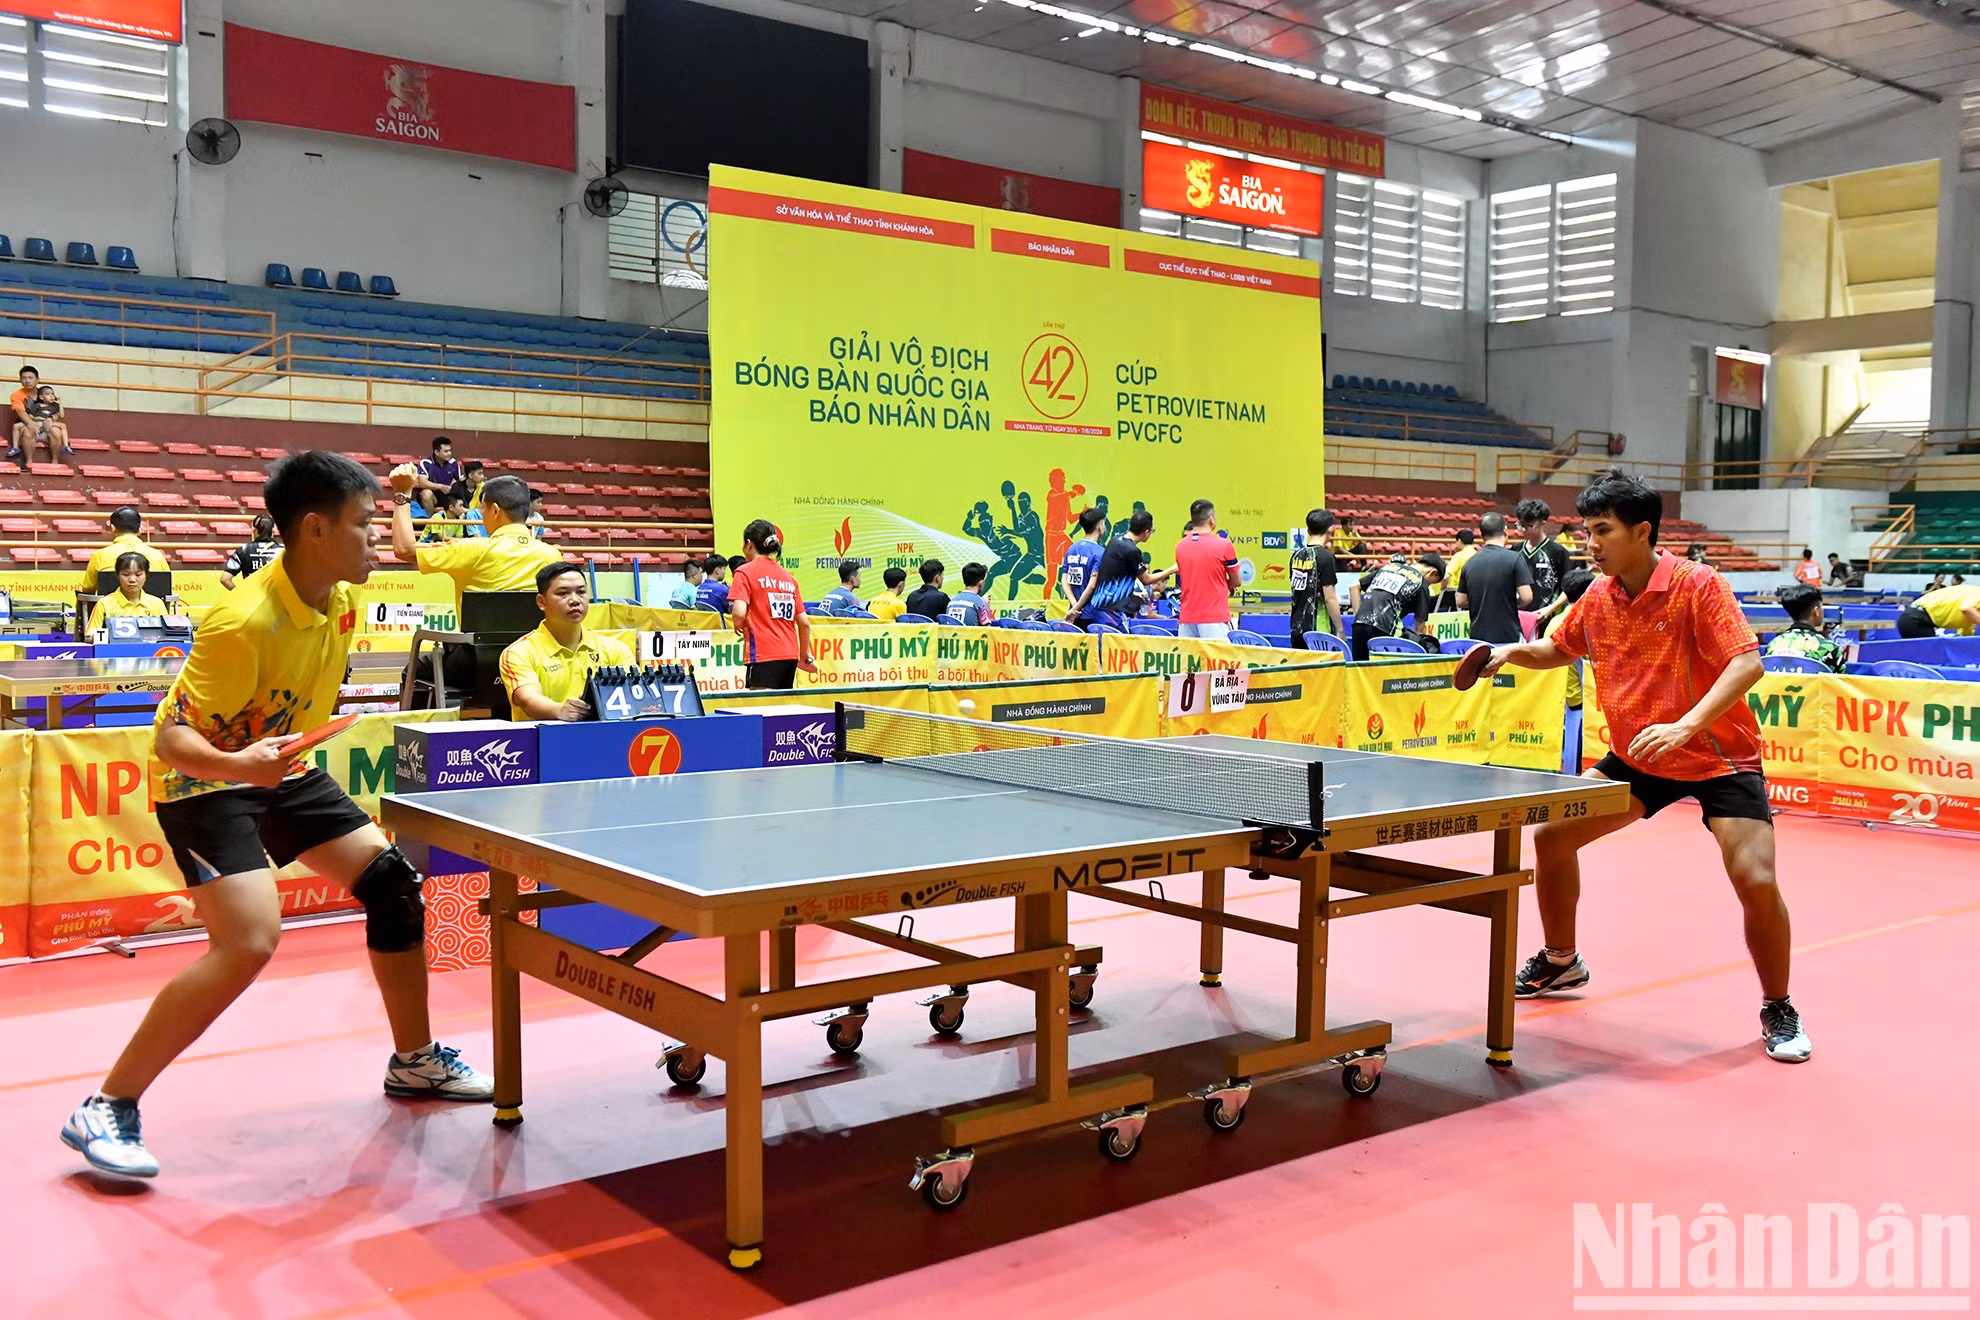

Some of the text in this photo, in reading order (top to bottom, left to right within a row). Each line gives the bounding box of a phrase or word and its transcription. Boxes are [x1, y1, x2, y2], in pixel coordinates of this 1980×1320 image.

[398, 112, 418, 123] BIA
[376, 118, 440, 141] SAIGON
[1202, 110, 1234, 138] TRUNG
[1268, 126, 1288, 149] CAO
[1242, 175, 1262, 190] BIA
[776, 204, 934, 235] SỞ VĂN HÓA VÀ THỂ THAO TỈNH KHÁNH HÒA
[1028, 242, 1074, 256] BÁO NHÂN DÂN
[1159, 262, 1172, 272] CỤC
[1211, 270, 1226, 279] THAO
[1259, 277, 1272, 285] NAM
[830, 330, 988, 374] GIẢI VÔ ĐỊCH
[735, 356, 990, 401] BÓNG BÀN QUỐC GIA
[1029, 345, 1076, 400] 42
[1116, 360, 1157, 385] CÚP
[810, 394, 990, 432] BÁO NHÂN DÂN
[1117, 392, 1265, 423] PETROVIETNAM
[1118, 420, 1182, 444] PVCFC
[794, 494, 884, 506] NHÀ ĐỒNG HÀNH CHÍNH
[897, 543, 914, 553] NPK
[1230, 536, 1259, 544] VNPT
[1264, 537, 1280, 546] BIDV
[786, 558, 799, 568] MAU
[887, 554, 925, 568] PHÚ MỸ
[8, 583, 32, 592] TỈNH
[34, 582, 68, 592] KHÁNH
[377, 582, 394, 590] VIỆT
[758, 576, 776, 588] TÂY
[377, 604, 386, 622] 0
[416, 610, 456, 631] PHÚ
[97, 630, 105, 642] T
[115, 620, 137, 637] 5
[1438, 618, 1460, 640] PHÚ
[653, 632, 664, 658] 0
[678, 639, 710, 649] TÂY NINH
[701, 638, 744, 667] PHÚ
[809, 631, 930, 661] NPK PHÚ MỸ
[994, 640, 1089, 671] NPK PHÚ MỸ
[1108, 646, 1181, 674] NPK PHÚ
[808, 668, 838, 684] Cho
[843, 668, 874, 683] mùa
[879, 666, 902, 683] bội
[908, 666, 929, 680] thu
[948, 668, 965, 683] bội
[969, 670, 988, 683] thu
[1226, 676, 1238, 689] RỊA
[354, 688, 373, 696] NPK
[1391, 682, 1402, 691] NHÀ
[1403, 680, 1417, 689] ĐỒNG
[1431, 678, 1444, 687] CHÍNH
[606, 684, 686, 716] 4 0 1 7
[1180, 676, 1195, 712] 0
[1212, 690, 1244, 706] VŨNG TÀU
[1255, 690, 1292, 701] HÀNH CHÍNH
[1006, 702, 1091, 718] NHÀ ĐỒNG HÀNH CHÍNH
[1748, 685, 1805, 727] MỸ
[1455, 720, 1469, 730] NPK
[1518, 720, 1535, 730] NPK
[1836, 696, 1910, 737] NPK
[1402, 736, 1437, 749] PETROVIETNAM
[1447, 731, 1463, 744] PHÚ
[1464, 730, 1476, 741] MỸ
[1509, 732, 1544, 744] PHÚ MỸ
[641, 735, 670, 776] 7
[768, 749, 805, 762] Double
[1761, 739, 1803, 763] thu
[1839, 745, 1973, 779] Cho mùa
[395, 764, 427, 783] Double FISH
[437, 768, 530, 784] Double FISH
[1564, 801, 1587, 818] 235
[1888, 793, 1938, 822] 20
[1937, 794, 1969, 809] Năm
[1376, 814, 1478, 845] 世乒赛器材供应商
[68, 837, 164, 875] Cho
[1054, 848, 1205, 890] MOFIT
[956, 881, 1025, 902] Double FISH
[828, 890, 889, 914] 中国乒乓
[61, 908, 110, 921] PHÂN BÓN
[53, 915, 112, 935] PHÚ MỸ
[51, 937, 68, 945] Cho
[555, 950, 656, 1012] DOUBLE FISH
